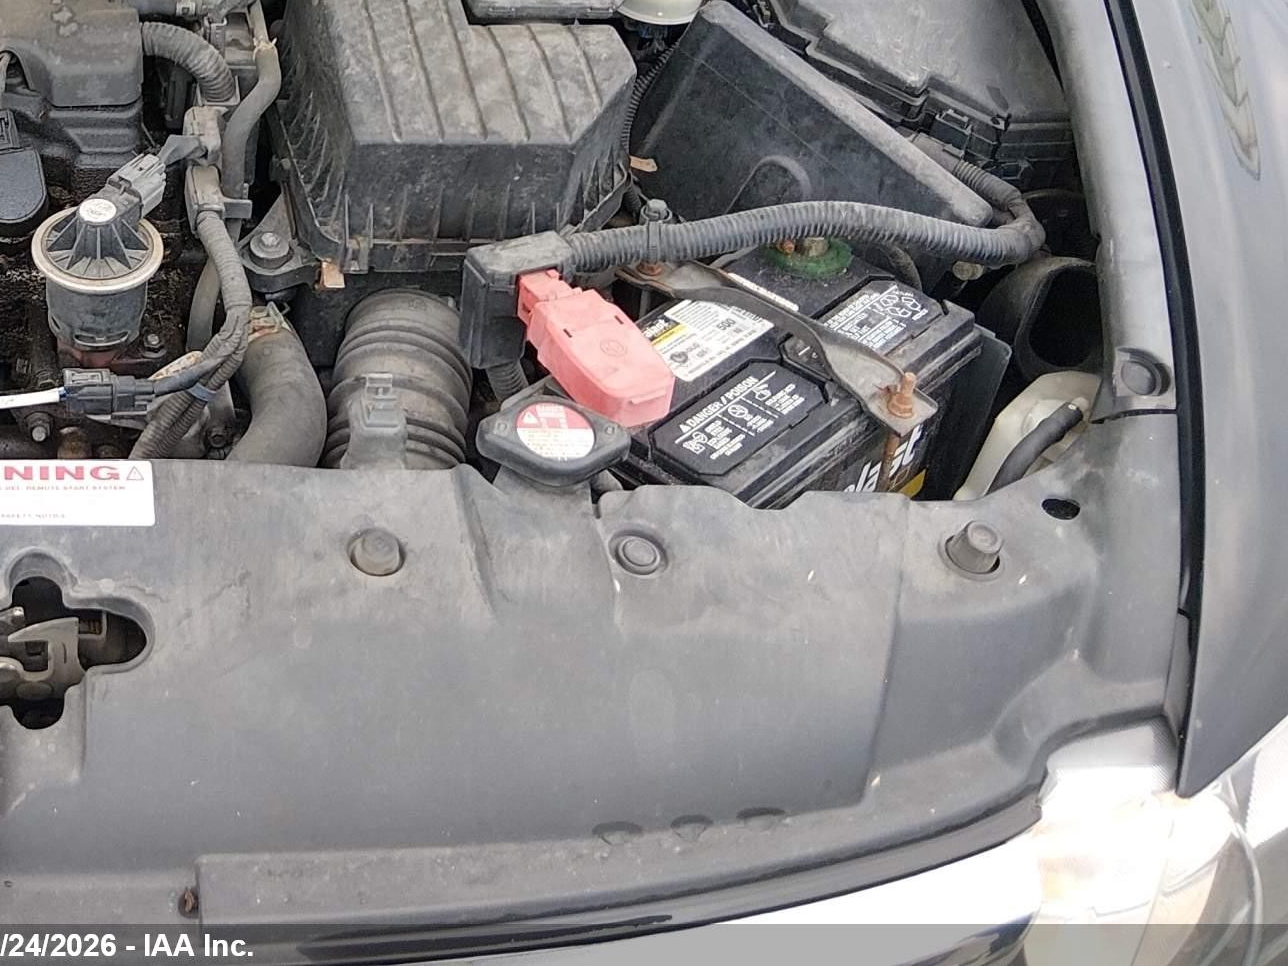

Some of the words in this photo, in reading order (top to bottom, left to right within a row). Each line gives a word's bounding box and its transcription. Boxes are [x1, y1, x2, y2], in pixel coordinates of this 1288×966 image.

[716, 317, 736, 331] 500
[686, 401, 724, 427] DANGER
[724, 375, 759, 401] POISON
